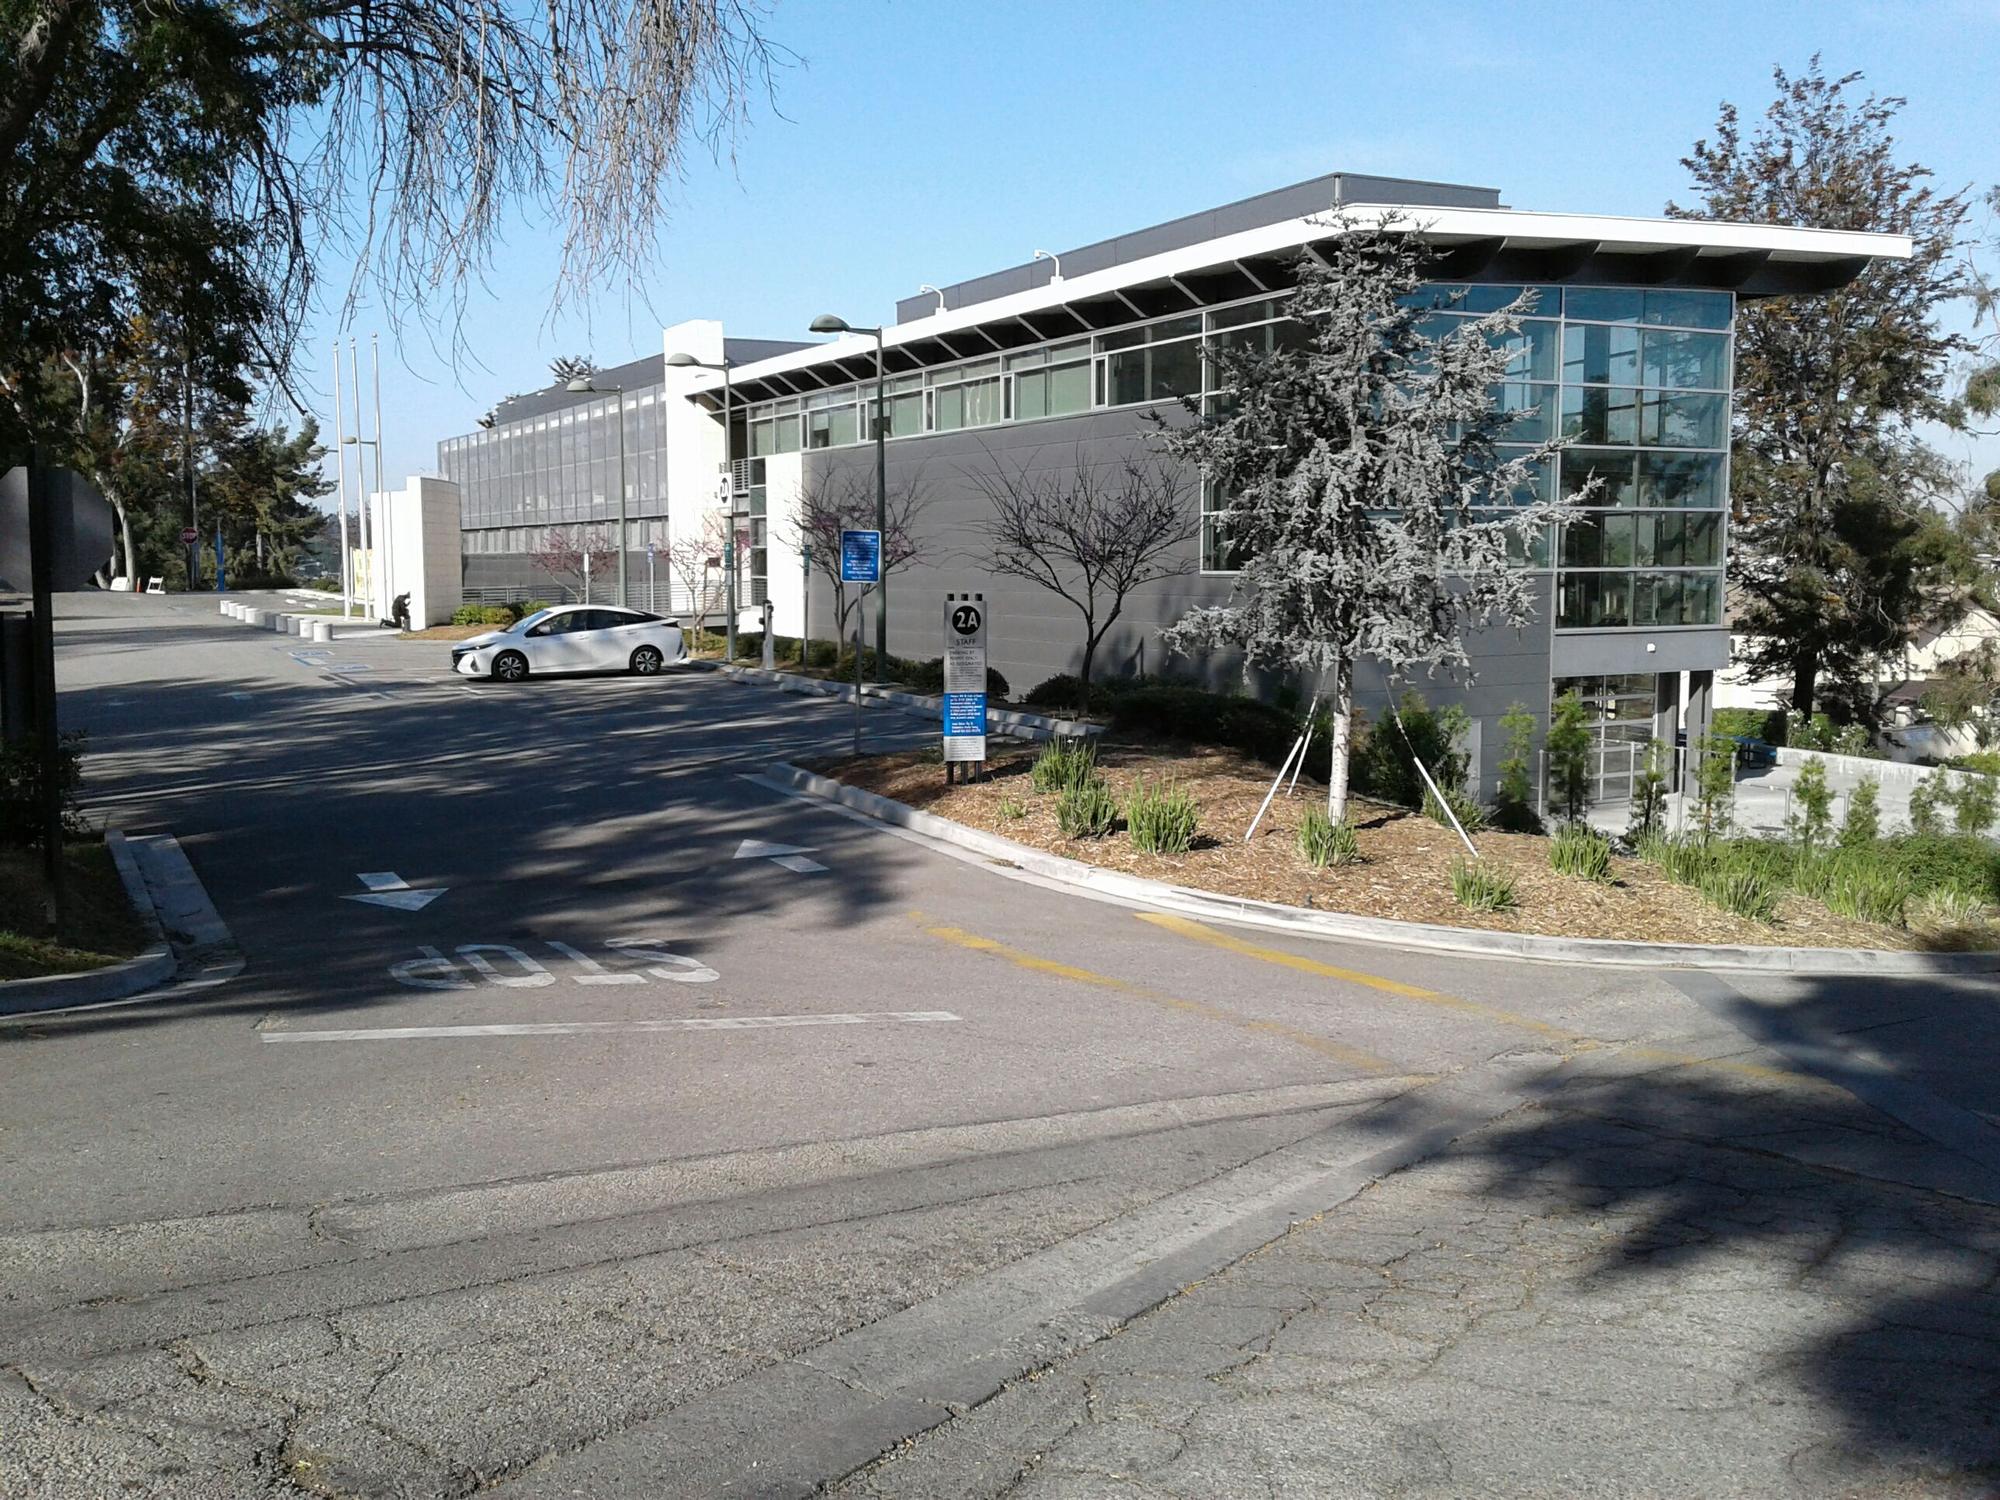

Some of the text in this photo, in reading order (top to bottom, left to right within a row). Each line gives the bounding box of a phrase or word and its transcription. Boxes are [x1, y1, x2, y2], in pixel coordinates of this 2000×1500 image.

[956, 611, 978, 628] 2A
[955, 638, 976, 646] STAFF
[388, 937, 721, 990] STOP
